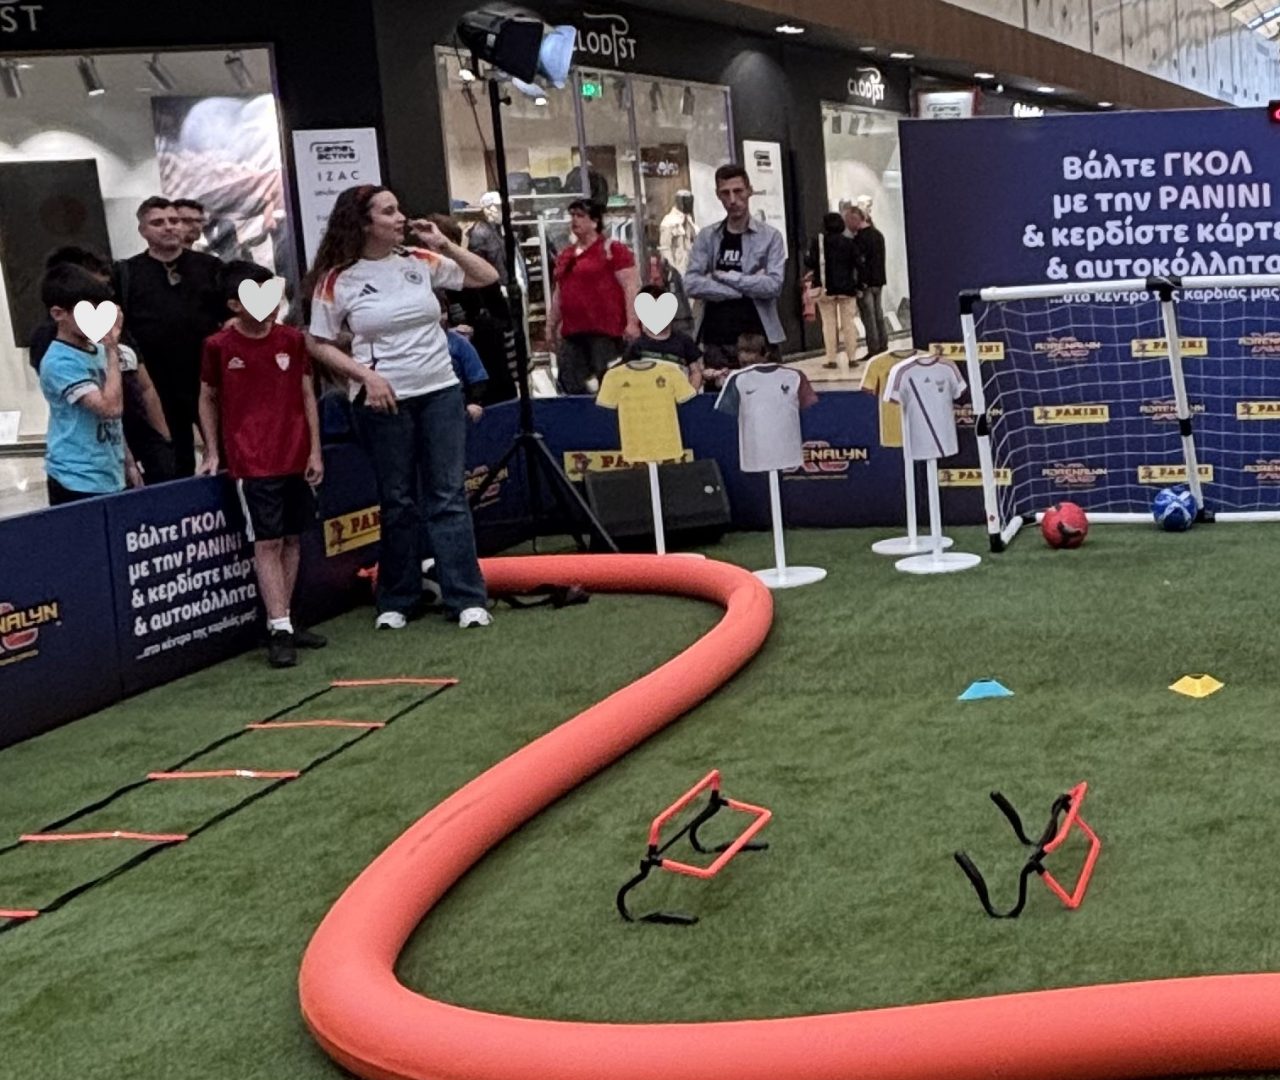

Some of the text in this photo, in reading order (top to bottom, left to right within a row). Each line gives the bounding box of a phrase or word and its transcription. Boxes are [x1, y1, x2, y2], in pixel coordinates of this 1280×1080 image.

[1063, 149, 1252, 180] Βάλτε ΓΚΟΛ
[1054, 183, 1272, 219] με την PANINI
[1022, 224, 1045, 247] &
[1052, 215, 1190, 251] κερδίστε
[1046, 256, 1069, 280] &
[802, 448, 867, 460] ENALYN
[126, 510, 226, 552] Βάλτε ΓΚΟΛ
[128, 561, 150, 586] με
[186, 532, 242, 563] PANINI
[132, 588, 145, 608] &
[148, 568, 221, 603] κερδίστε
[134, 616, 149, 636] &
